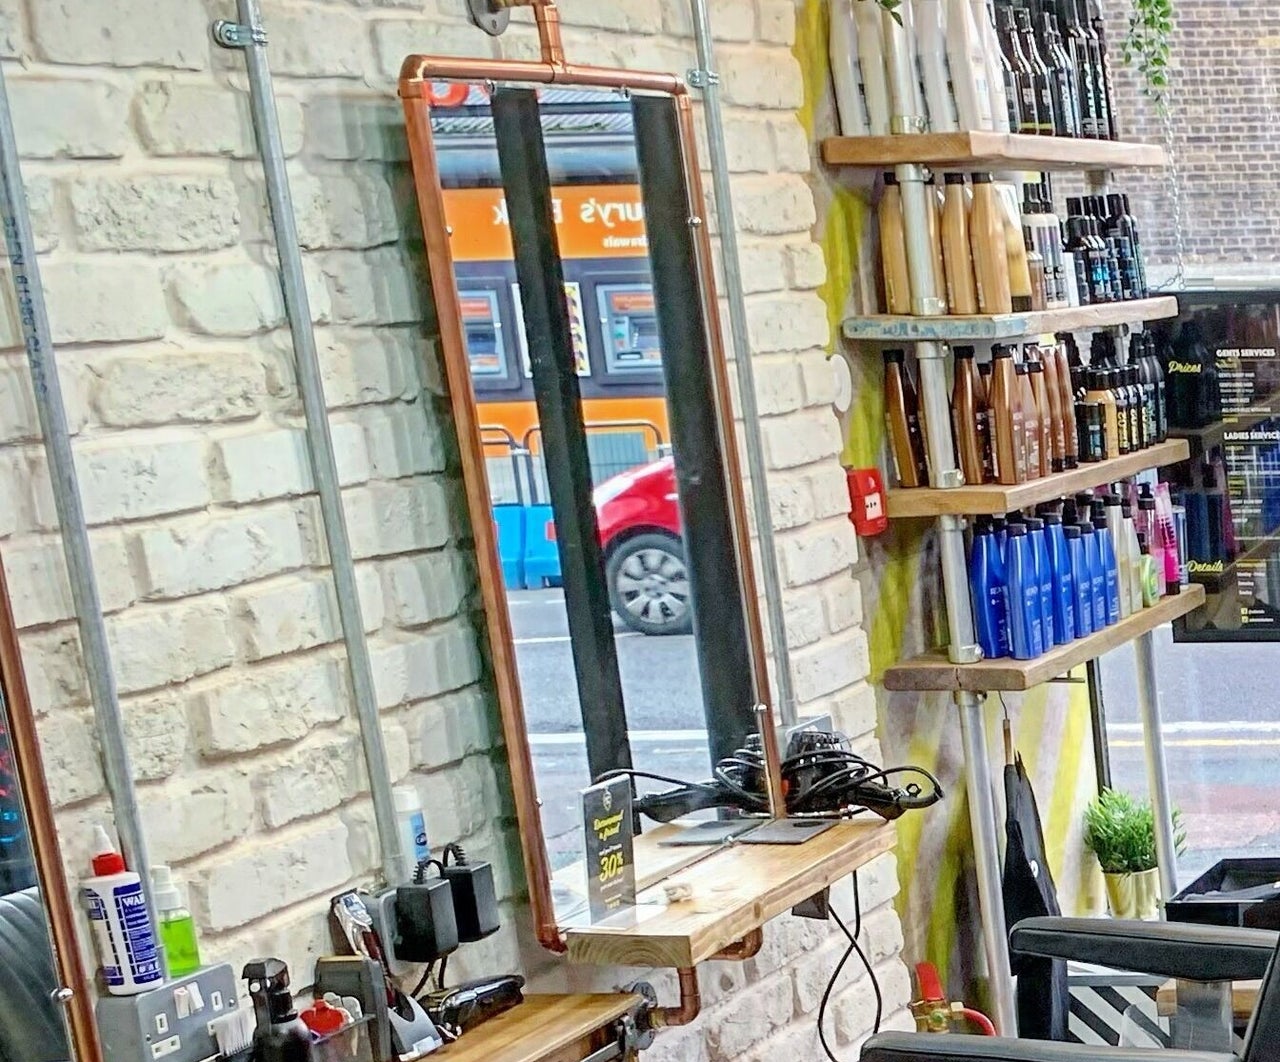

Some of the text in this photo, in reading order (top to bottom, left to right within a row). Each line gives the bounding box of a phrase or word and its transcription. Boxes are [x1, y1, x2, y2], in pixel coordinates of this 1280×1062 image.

[1216, 348, 1276, 357] GENTS SERVICES
[1168, 360, 1202, 374] Prices
[1223, 431, 1249, 440] LADIES
[1188, 560, 1224, 573] Details
[600, 851, 624, 881] 30%
